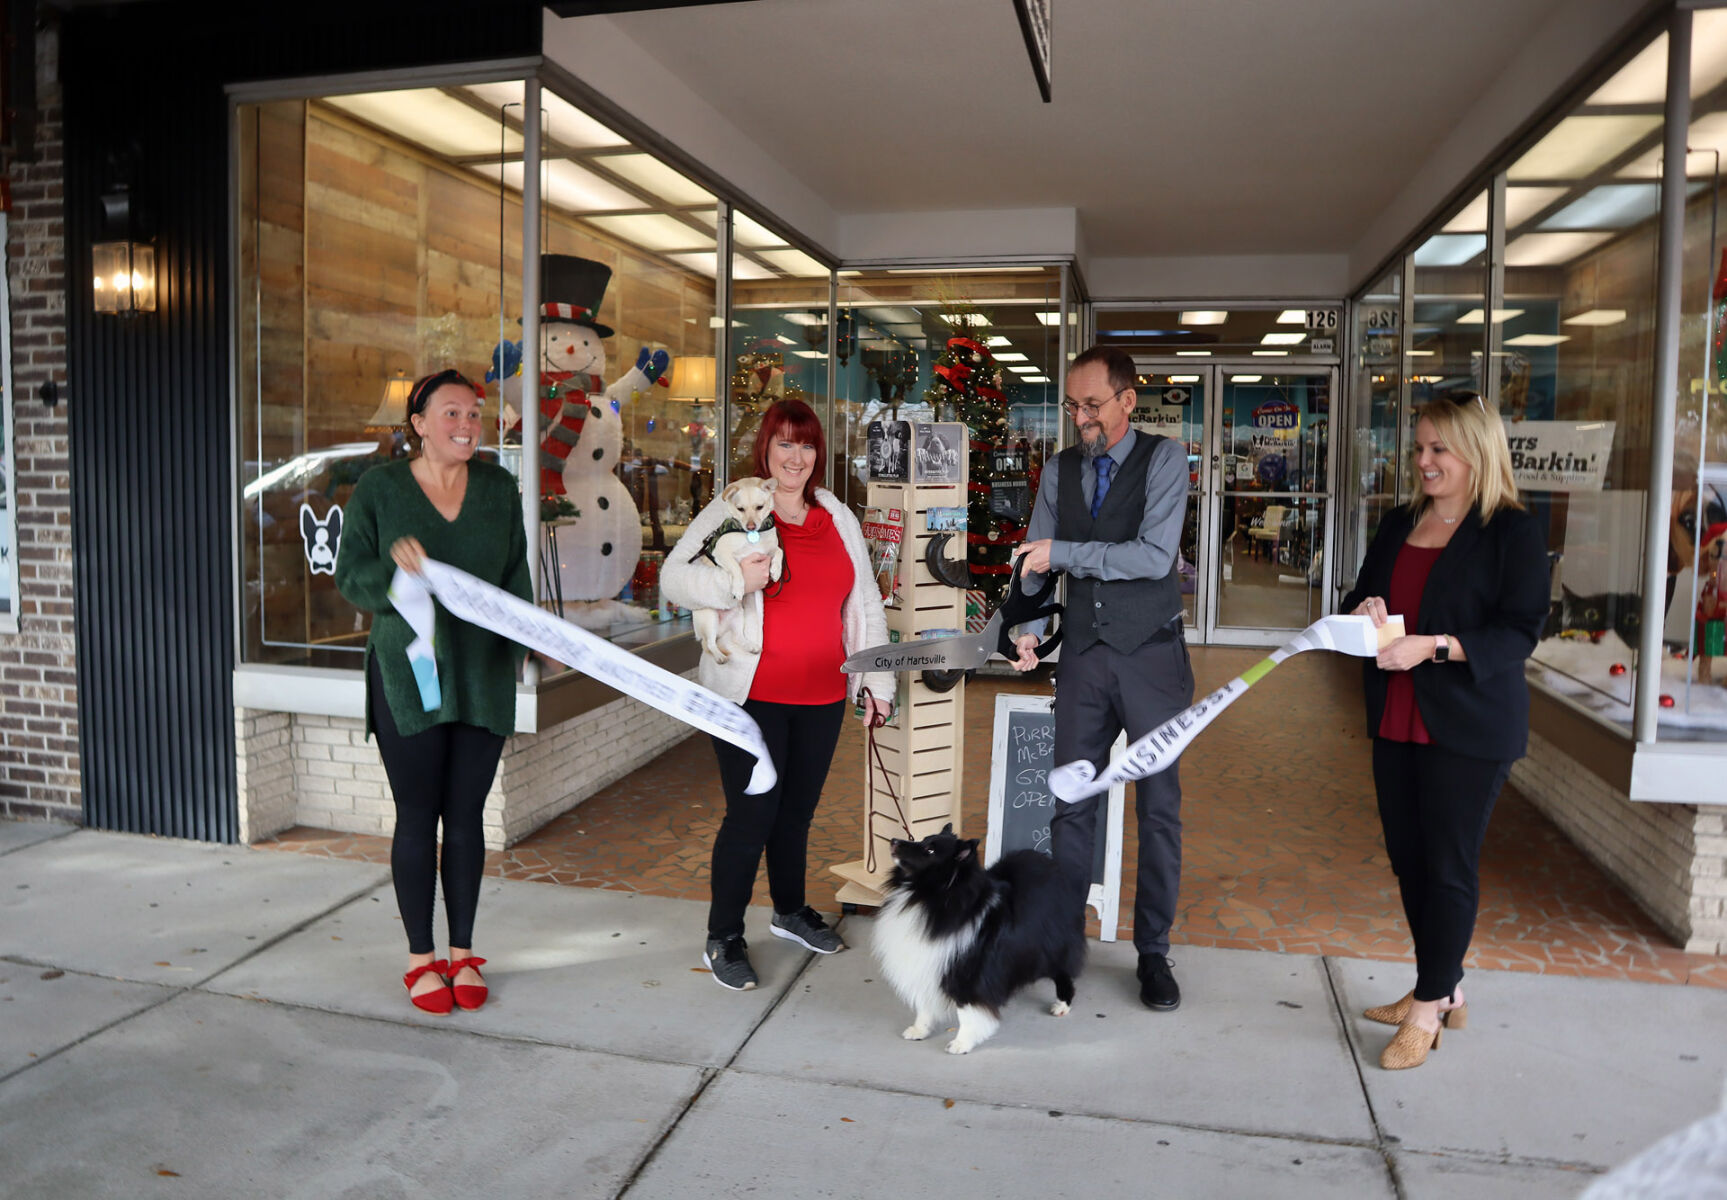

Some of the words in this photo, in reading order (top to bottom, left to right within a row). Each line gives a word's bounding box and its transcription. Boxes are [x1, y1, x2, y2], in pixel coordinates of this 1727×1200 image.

[1307, 311, 1336, 328] 126
[1258, 414, 1293, 427] OPEN
[995, 457, 1023, 472] OPEN
[1511, 452, 1596, 472] Barkin'
[875, 657, 892, 669] City
[895, 655, 905, 666] of
[907, 654, 946, 666] Hartsville
